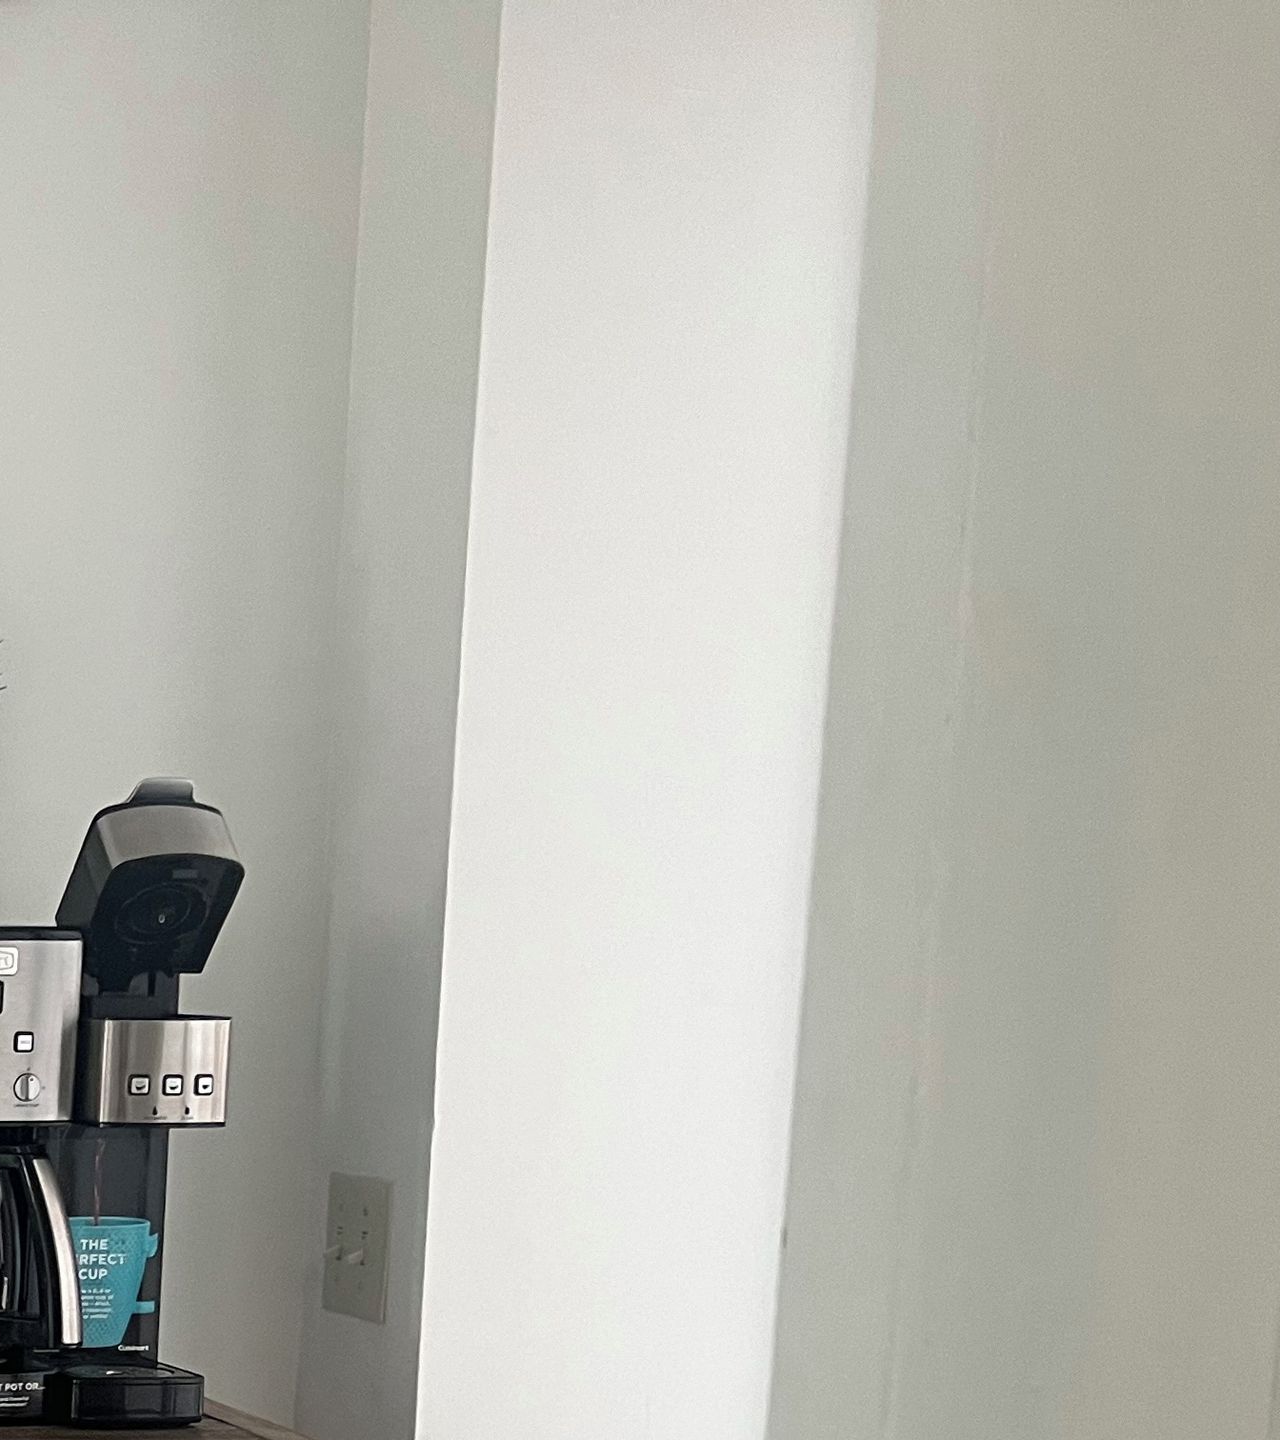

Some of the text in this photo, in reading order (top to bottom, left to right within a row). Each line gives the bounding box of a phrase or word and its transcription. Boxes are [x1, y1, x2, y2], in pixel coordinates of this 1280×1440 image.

[80, 1238, 109, 1250] THE
[76, 1253, 127, 1266] RFECT
[78, 1268, 108, 1280] CUP
[4, 1382, 24, 1392] POT
